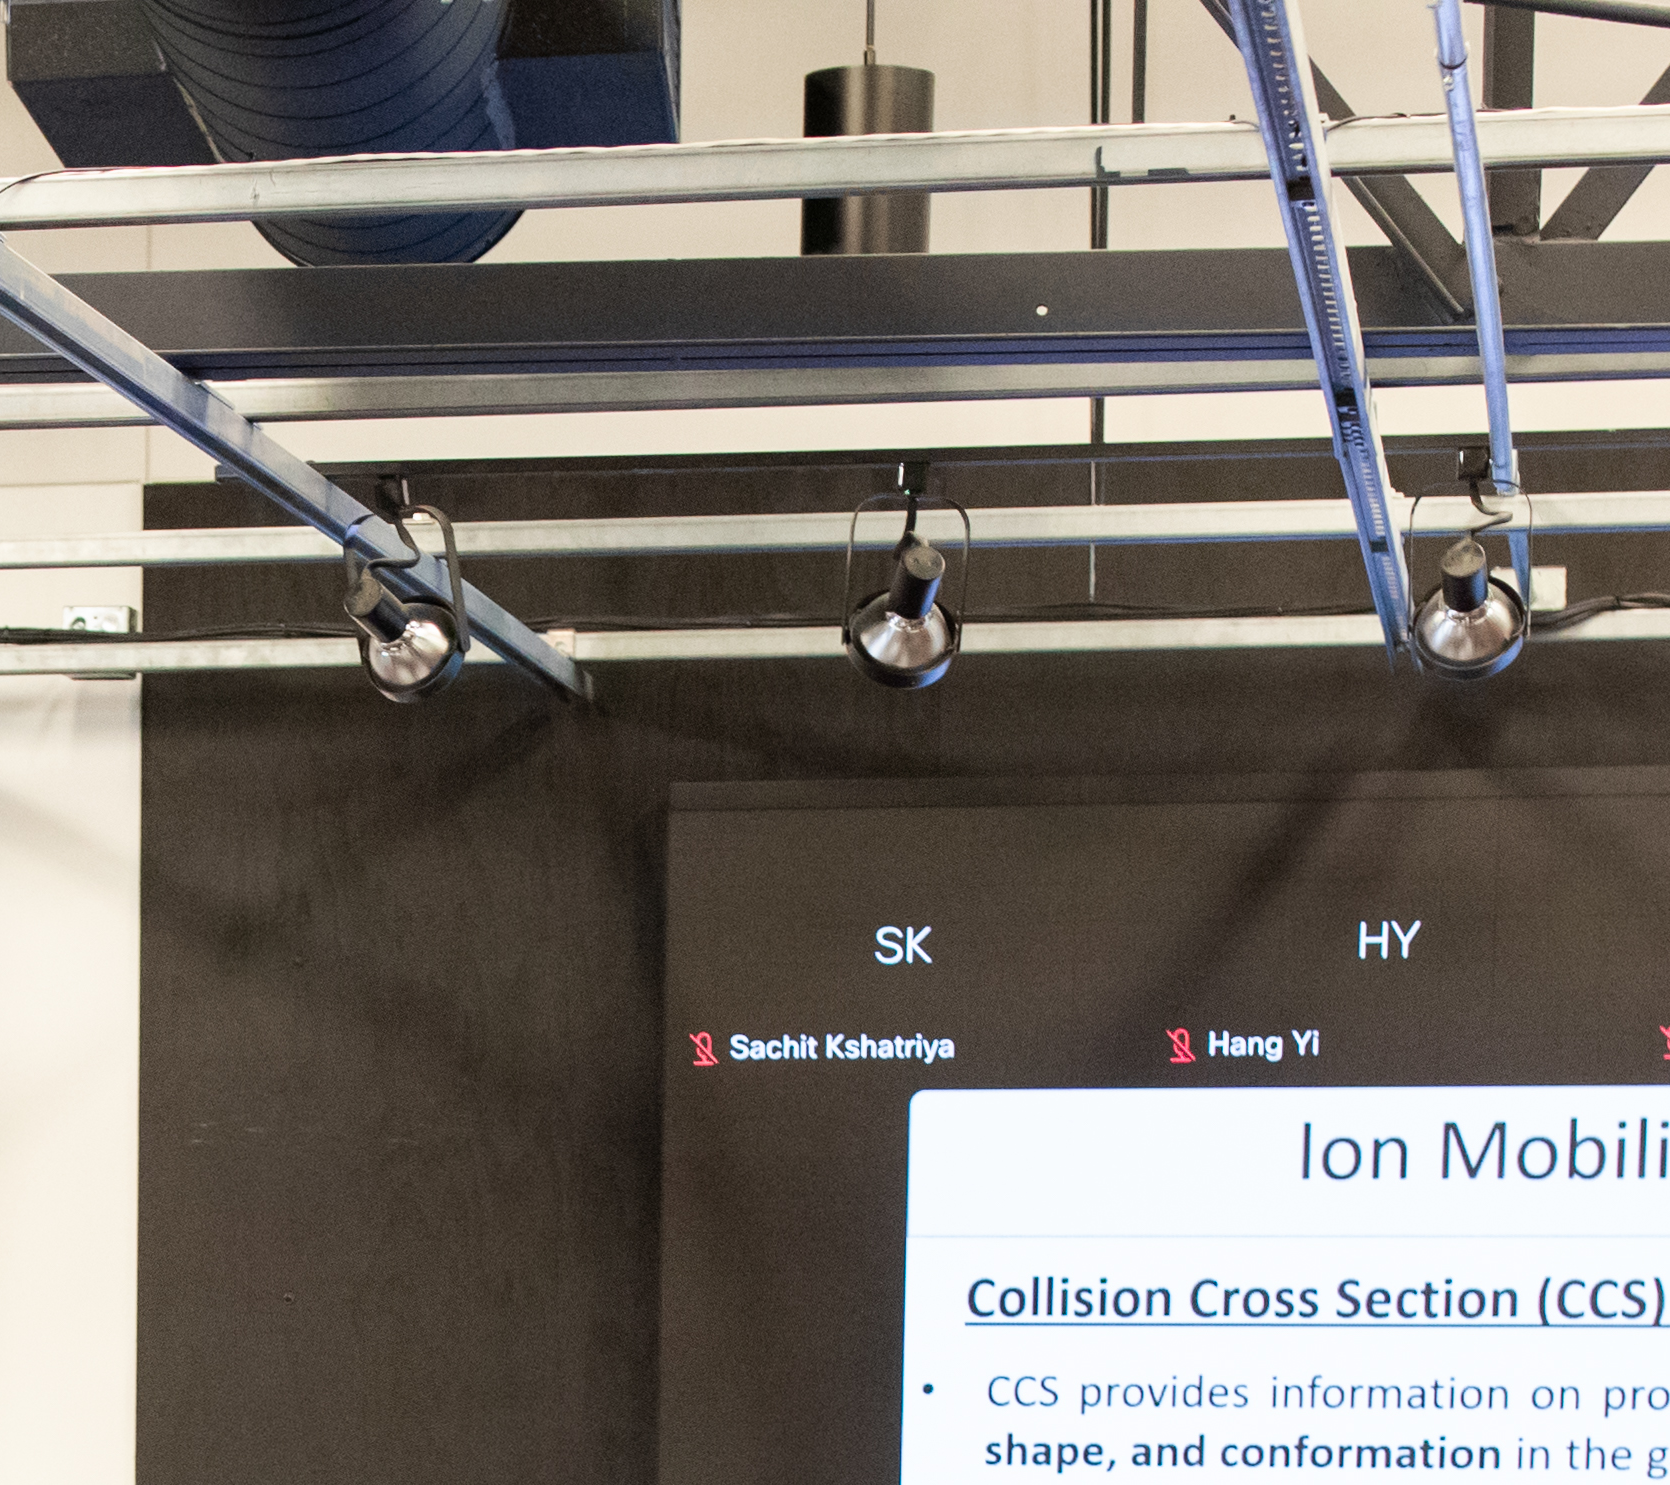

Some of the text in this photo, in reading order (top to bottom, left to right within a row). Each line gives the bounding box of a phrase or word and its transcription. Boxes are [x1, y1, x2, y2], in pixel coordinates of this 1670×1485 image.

[874, 926, 933, 964] SK
[1358, 920, 1422, 959] HY
[729, 1033, 956, 1065] Sachit Kshatriya
[1208, 1030, 1320, 1062] Hang Yi
[1301, 1121, 1408, 1180] Ion
[967, 1275, 1172, 1318] Collision
[1189, 1279, 1319, 1319] Cross
[1335, 1278, 1518, 1319] Section
[986, 1375, 1060, 1408] CCS
[1079, 1374, 1250, 1415] provides
[1271, 1374, 1510, 1410] information
[1530, 1385, 1581, 1410] on
[984, 1432, 1117, 1475] shape,
[1130, 1434, 1206, 1468] and
[1220, 1434, 1501, 1470] conformation
[1517, 1446, 1551, 1470] in
[1567, 1437, 1633, 1470] the
